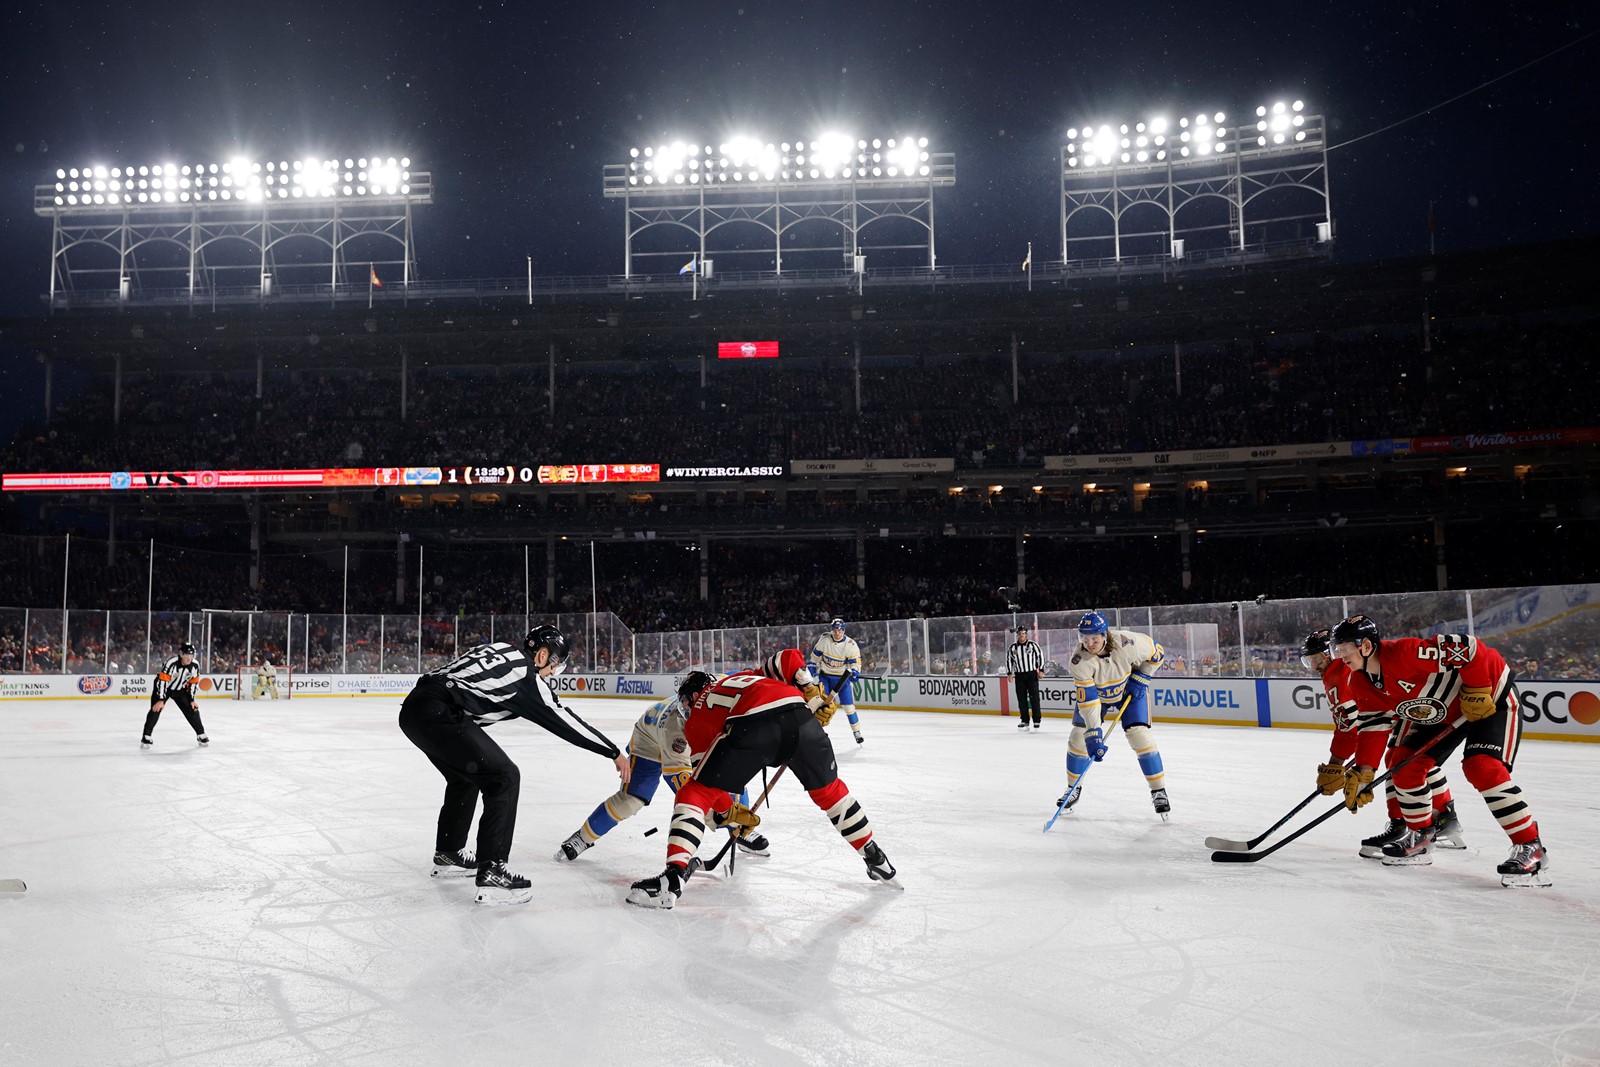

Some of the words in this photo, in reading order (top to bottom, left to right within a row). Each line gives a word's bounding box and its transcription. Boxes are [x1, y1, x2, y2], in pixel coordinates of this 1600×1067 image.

[1465, 432, 1516, 448] Winter
[1518, 433, 1563, 442] CLASSIC
[1154, 454, 1170, 463] CAT
[448, 468, 458, 483] 1
[520, 467, 533, 482] 0
[666, 466, 783, 477] #WINTERCLASSIC
[144, 472, 188, 487] VS
[468, 647, 507, 670] 53
[1418, 646, 1439, 660] 5
[130, 677, 146, 685] sub
[199, 677, 243, 692] OVER
[277, 678, 330, 690] terprise
[337, 680, 372, 688] O'HARE
[379, 680, 416, 688] MIDWAY
[550, 677, 606, 691] DISCOVER
[616, 676, 654, 694] FASTENAL
[919, 679, 986, 696] BODYARMOR
[1397, 680, 1416, 694] A
[864, 678, 899, 702] NFP
[1038, 688, 1077, 705] nterp
[1077, 688, 1086, 702] 0
[951, 697, 970, 706] Sports
[1154, 689, 1240, 708] FANDUEL
[1459, 695, 1485, 703] UER
[1466, 743, 1502, 752] BAUER
[671, 771, 691, 790] 18
